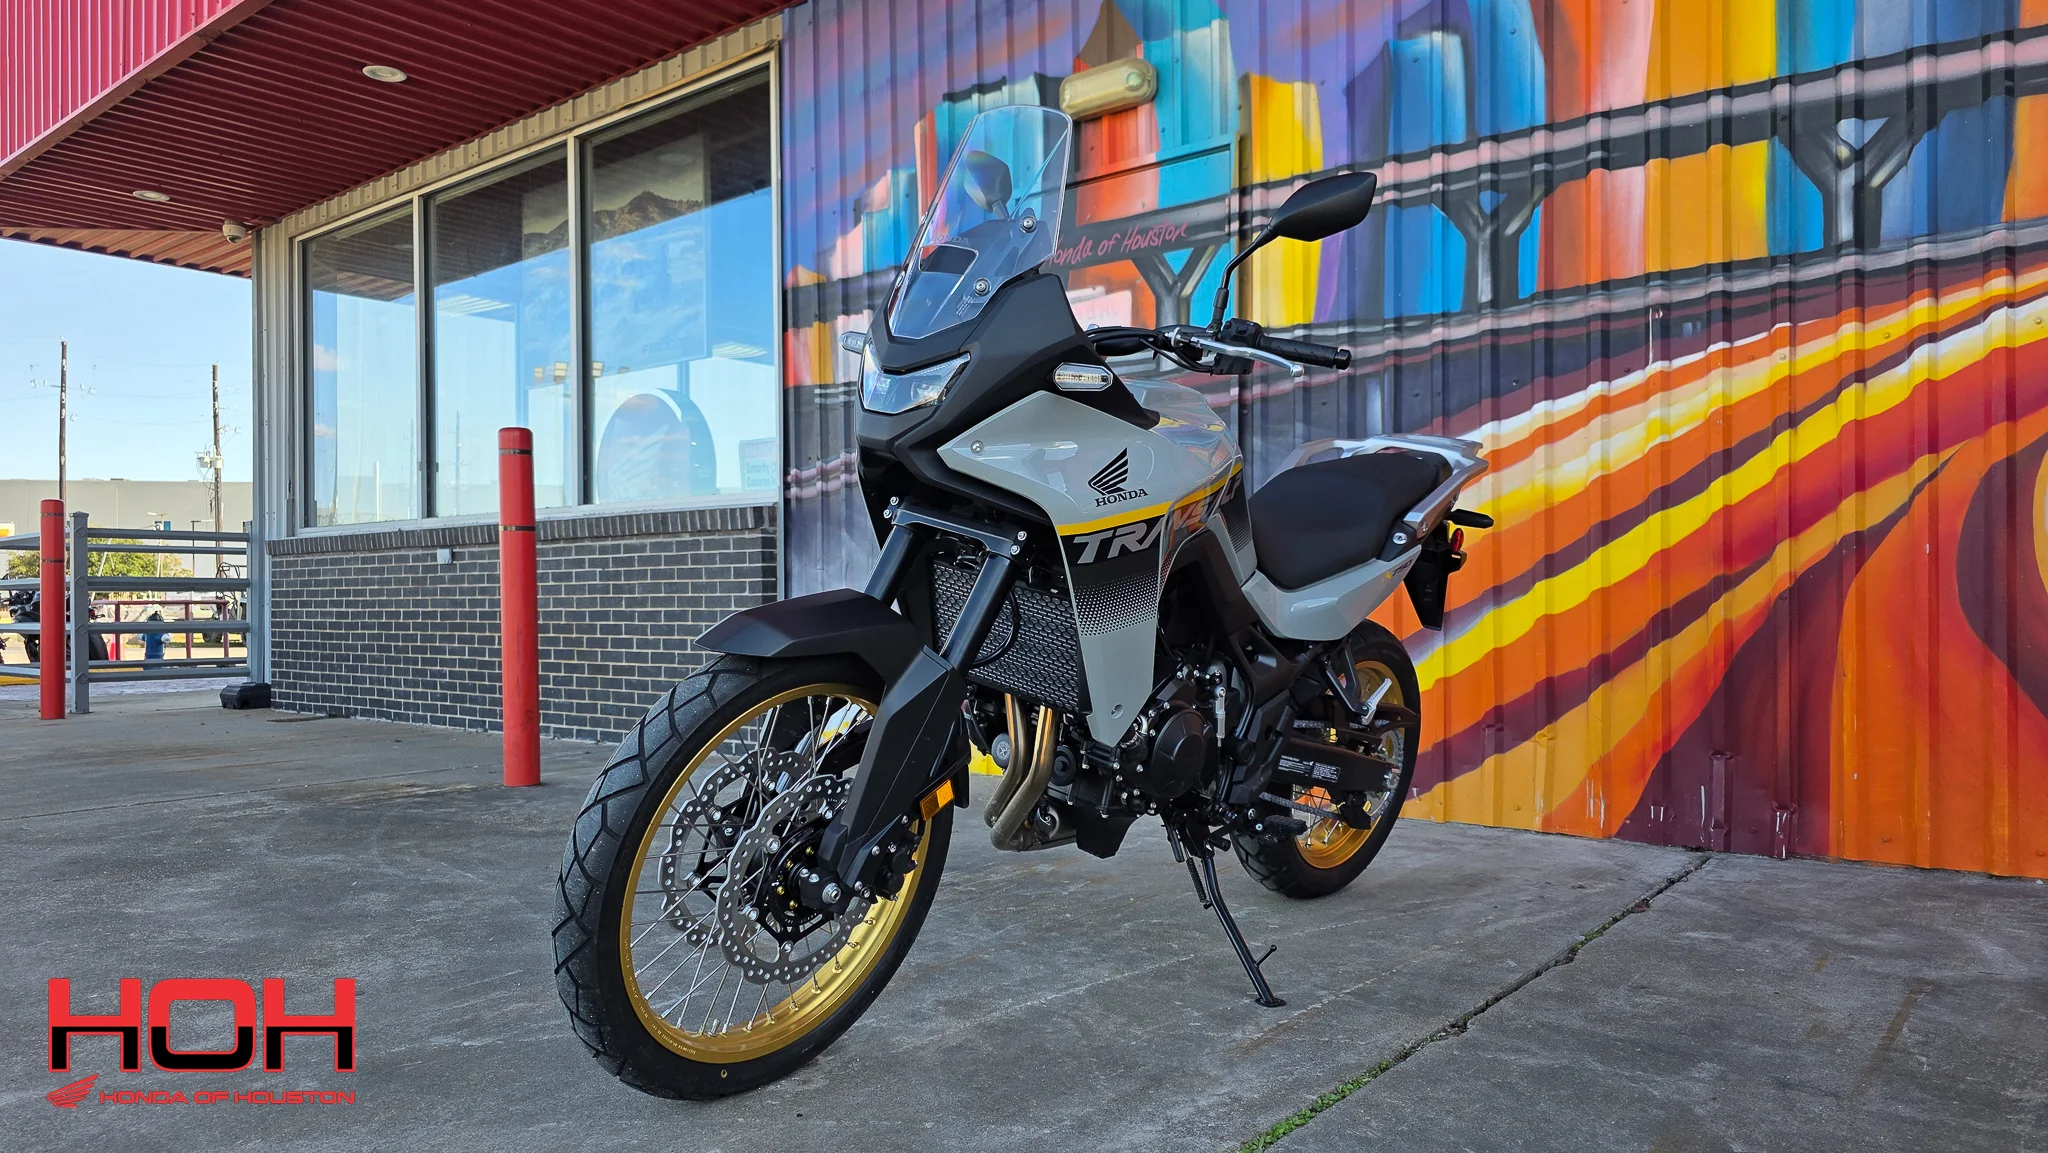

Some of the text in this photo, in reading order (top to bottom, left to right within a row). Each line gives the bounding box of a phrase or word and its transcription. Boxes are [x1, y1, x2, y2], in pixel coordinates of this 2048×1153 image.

[930, 234, 969, 247] HONDA
[1097, 232, 1121, 256] of
[1121, 219, 1188, 253] Houston
[1095, 488, 1149, 507] HONDA
